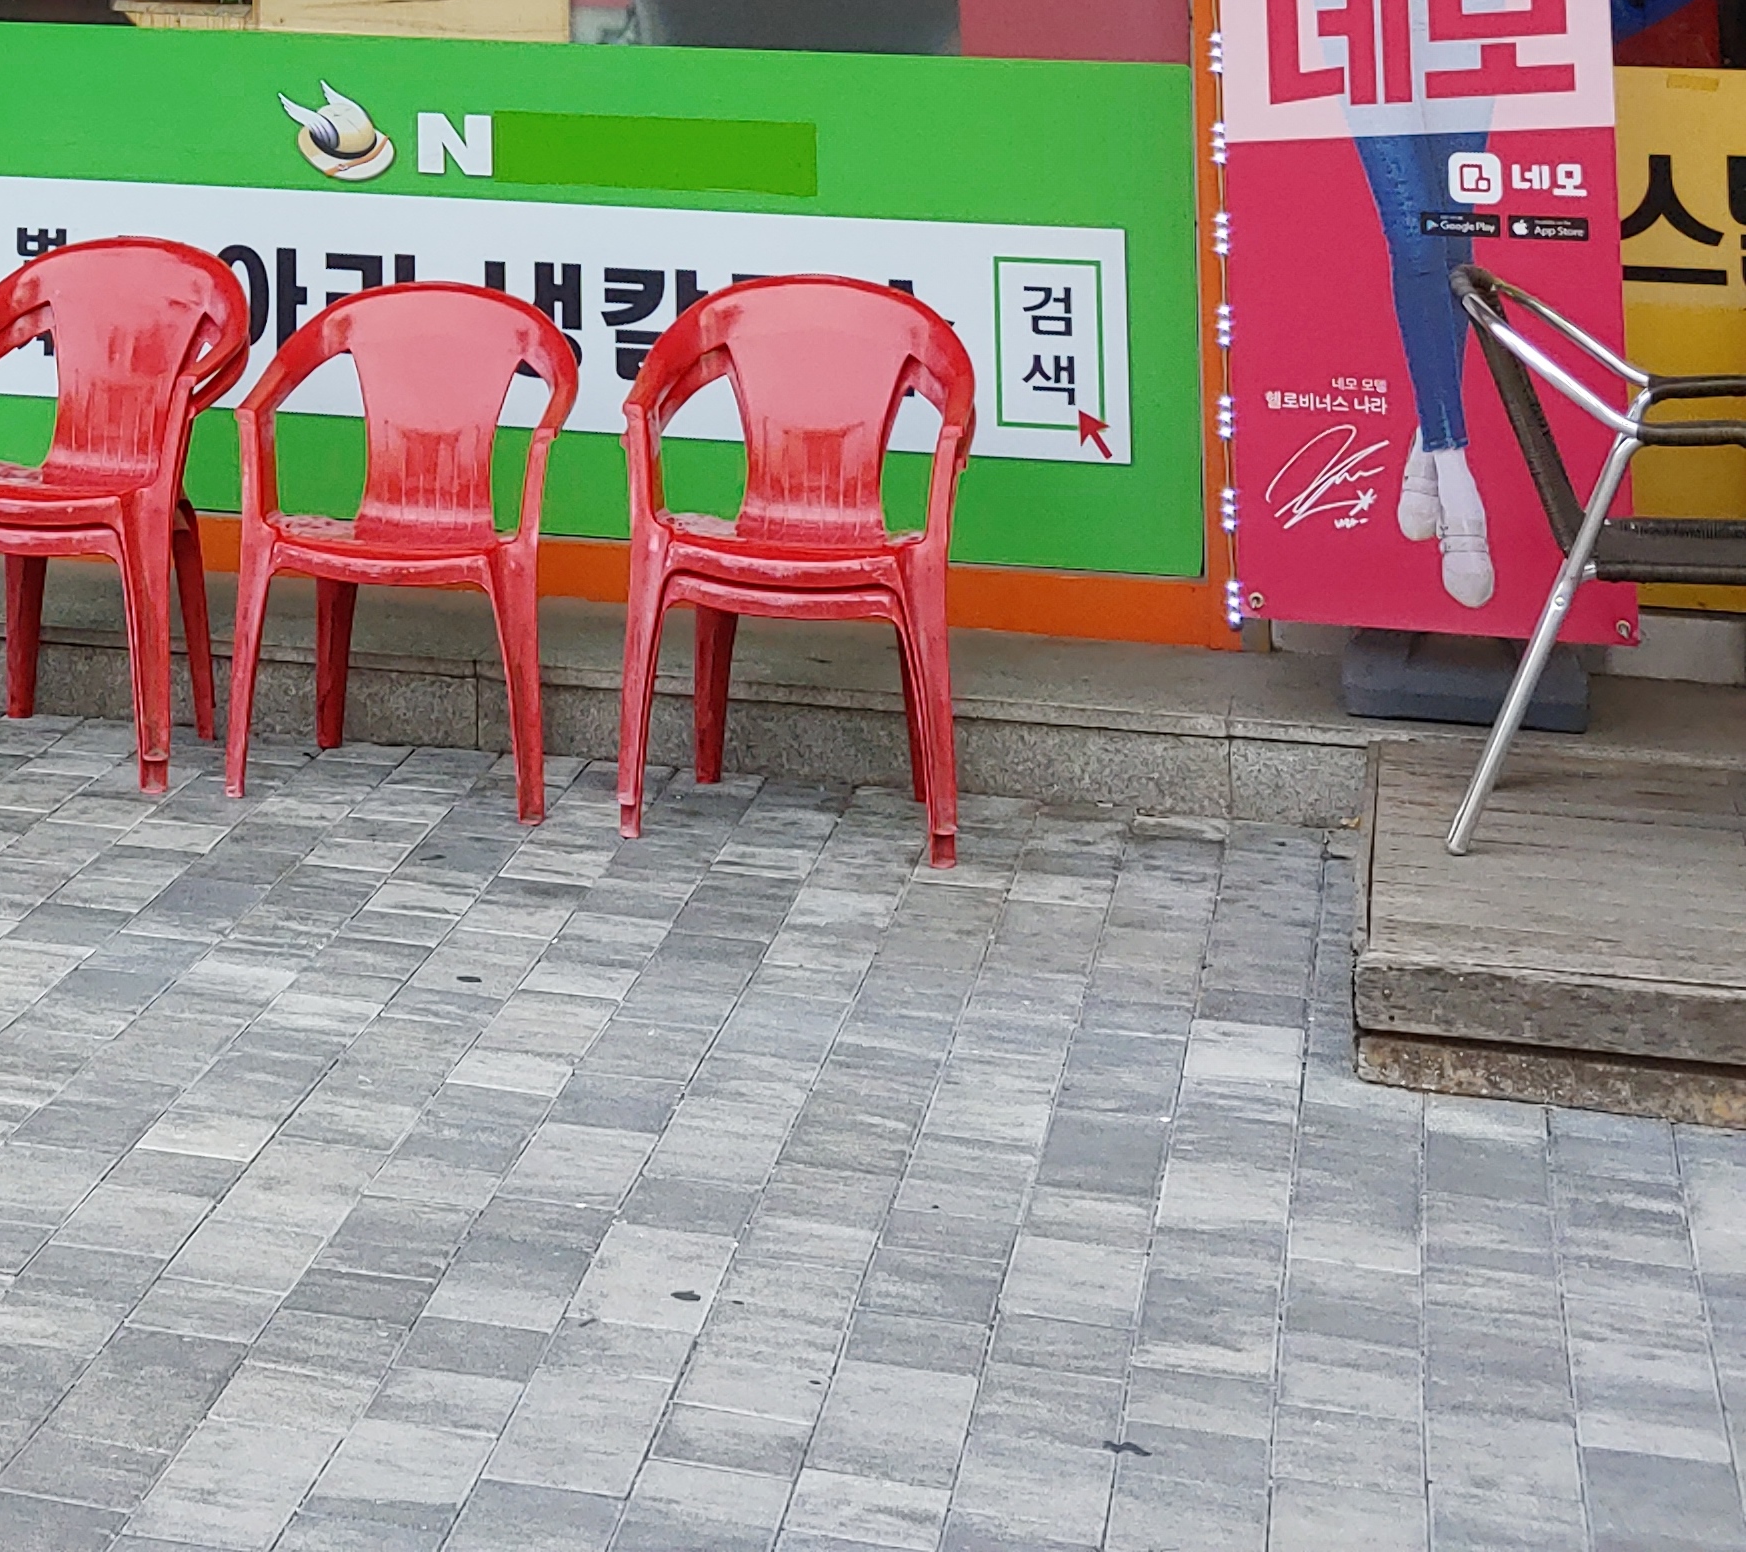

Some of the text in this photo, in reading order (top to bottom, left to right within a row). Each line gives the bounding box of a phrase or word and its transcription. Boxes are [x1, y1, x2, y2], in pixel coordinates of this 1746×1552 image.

[1511, 163, 1588, 197] 네모
[1440, 220, 1474, 233] Google
[1022, 284, 1077, 405] 검색
[1332, 377, 1357, 390] 네모
[1265, 390, 1387, 415] 헬로비너스 나라
